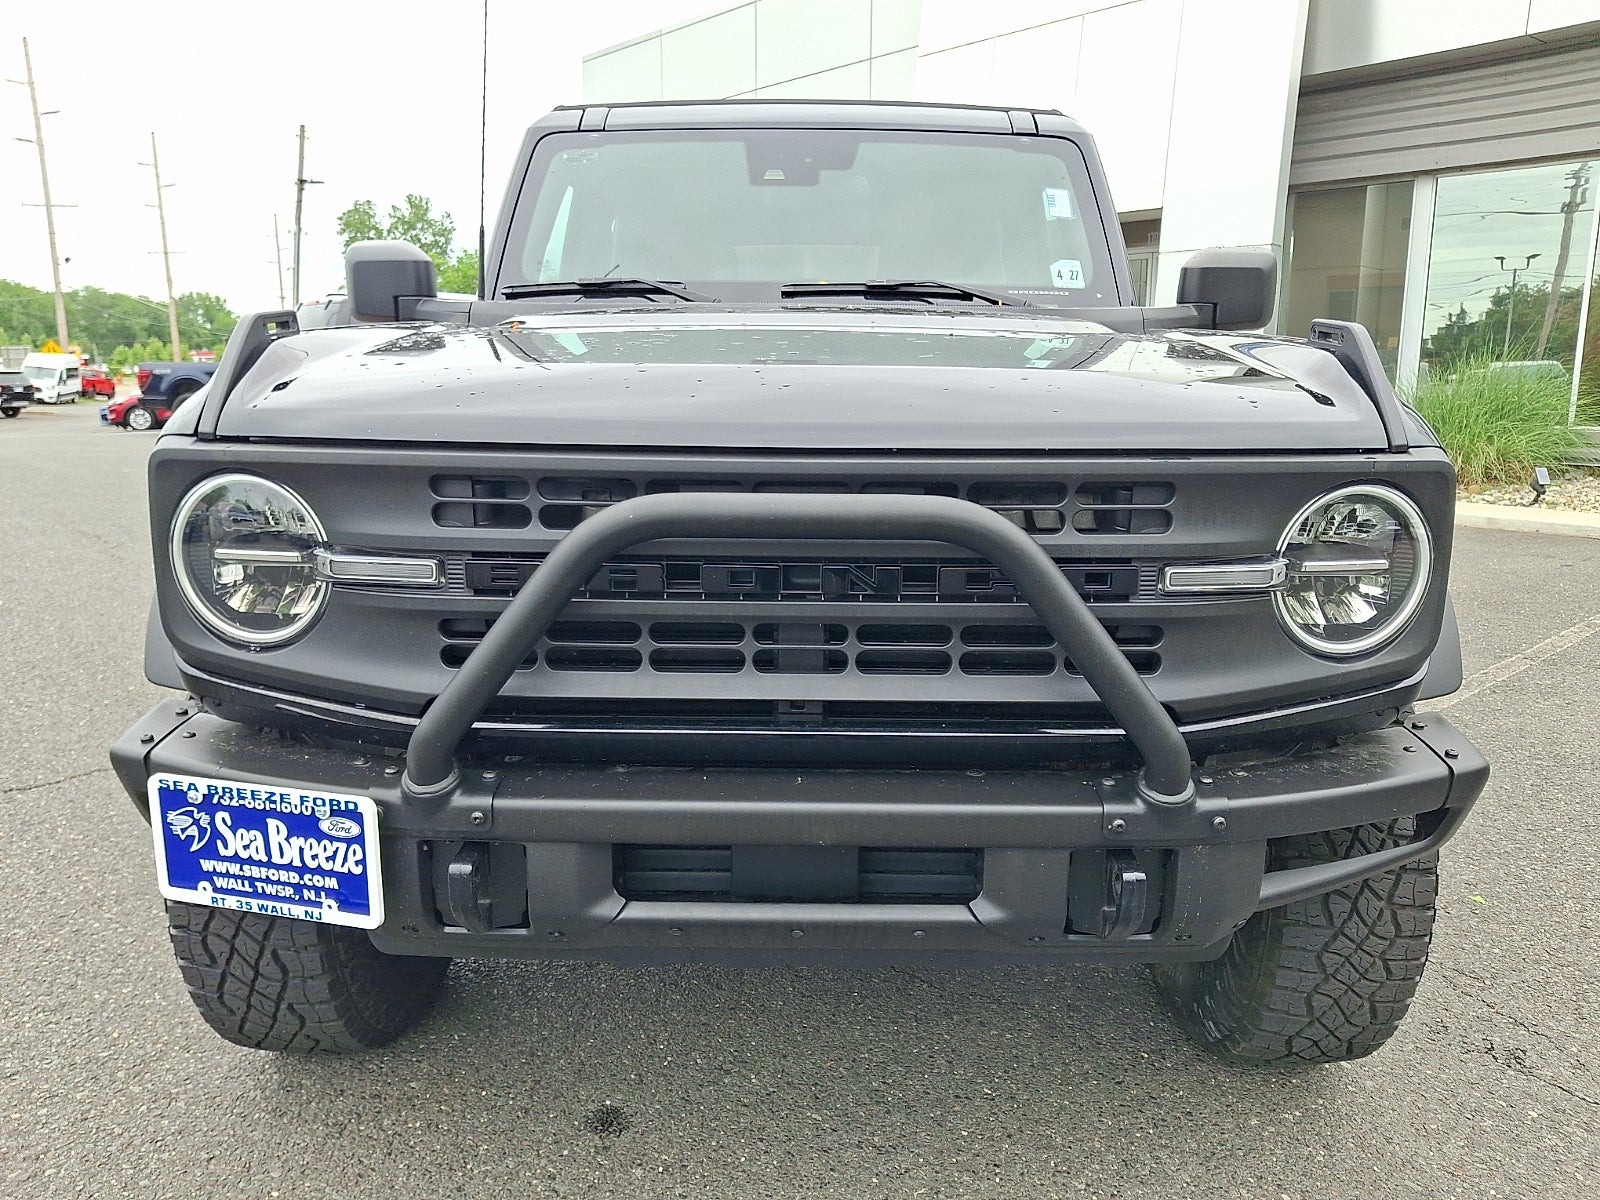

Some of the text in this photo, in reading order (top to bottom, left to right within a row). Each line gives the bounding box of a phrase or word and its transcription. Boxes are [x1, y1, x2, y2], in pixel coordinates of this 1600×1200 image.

[1057, 269, 1079, 281] 4 27
[158, 779, 359, 813] SEA BREEZE FORD
[327, 819, 353, 835] Ford
[200, 859, 339, 890] WWW.SBFORD.COM
[213, 876, 253, 892] WALL
[211, 896, 323, 921] RT. 35 WALL, NJ
